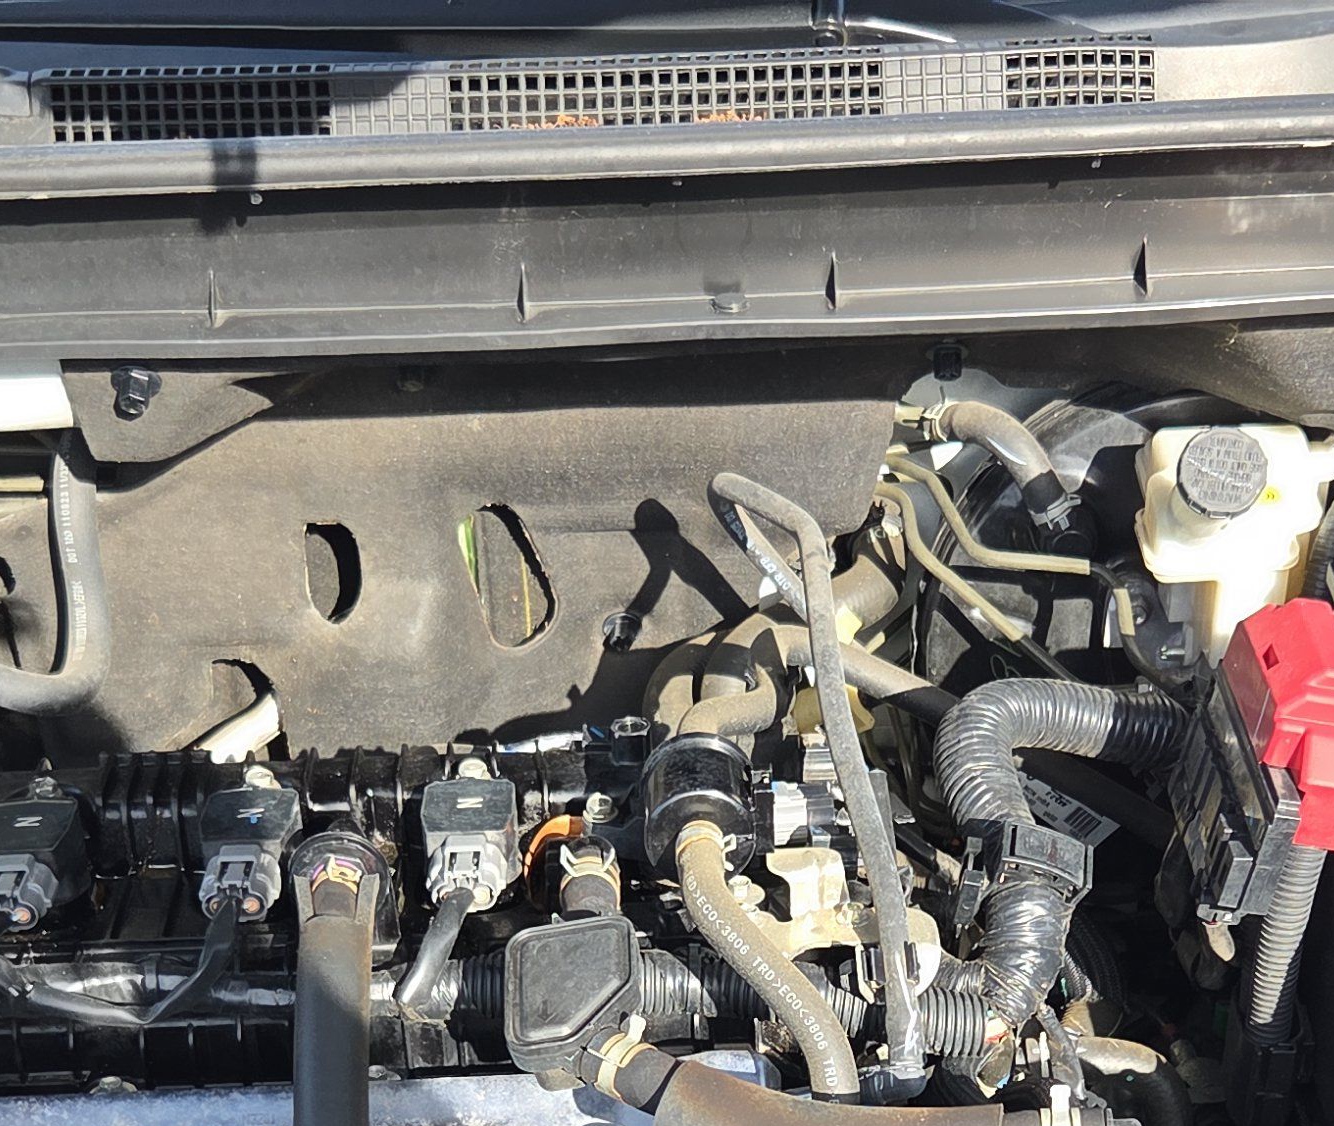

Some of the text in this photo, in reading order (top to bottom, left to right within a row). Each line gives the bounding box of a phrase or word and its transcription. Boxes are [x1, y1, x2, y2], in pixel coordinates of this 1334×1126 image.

[720, 925, 750, 956] 3806
[803, 1013, 828, 1051] 3806
[822, 1056, 839, 1088] TRD
